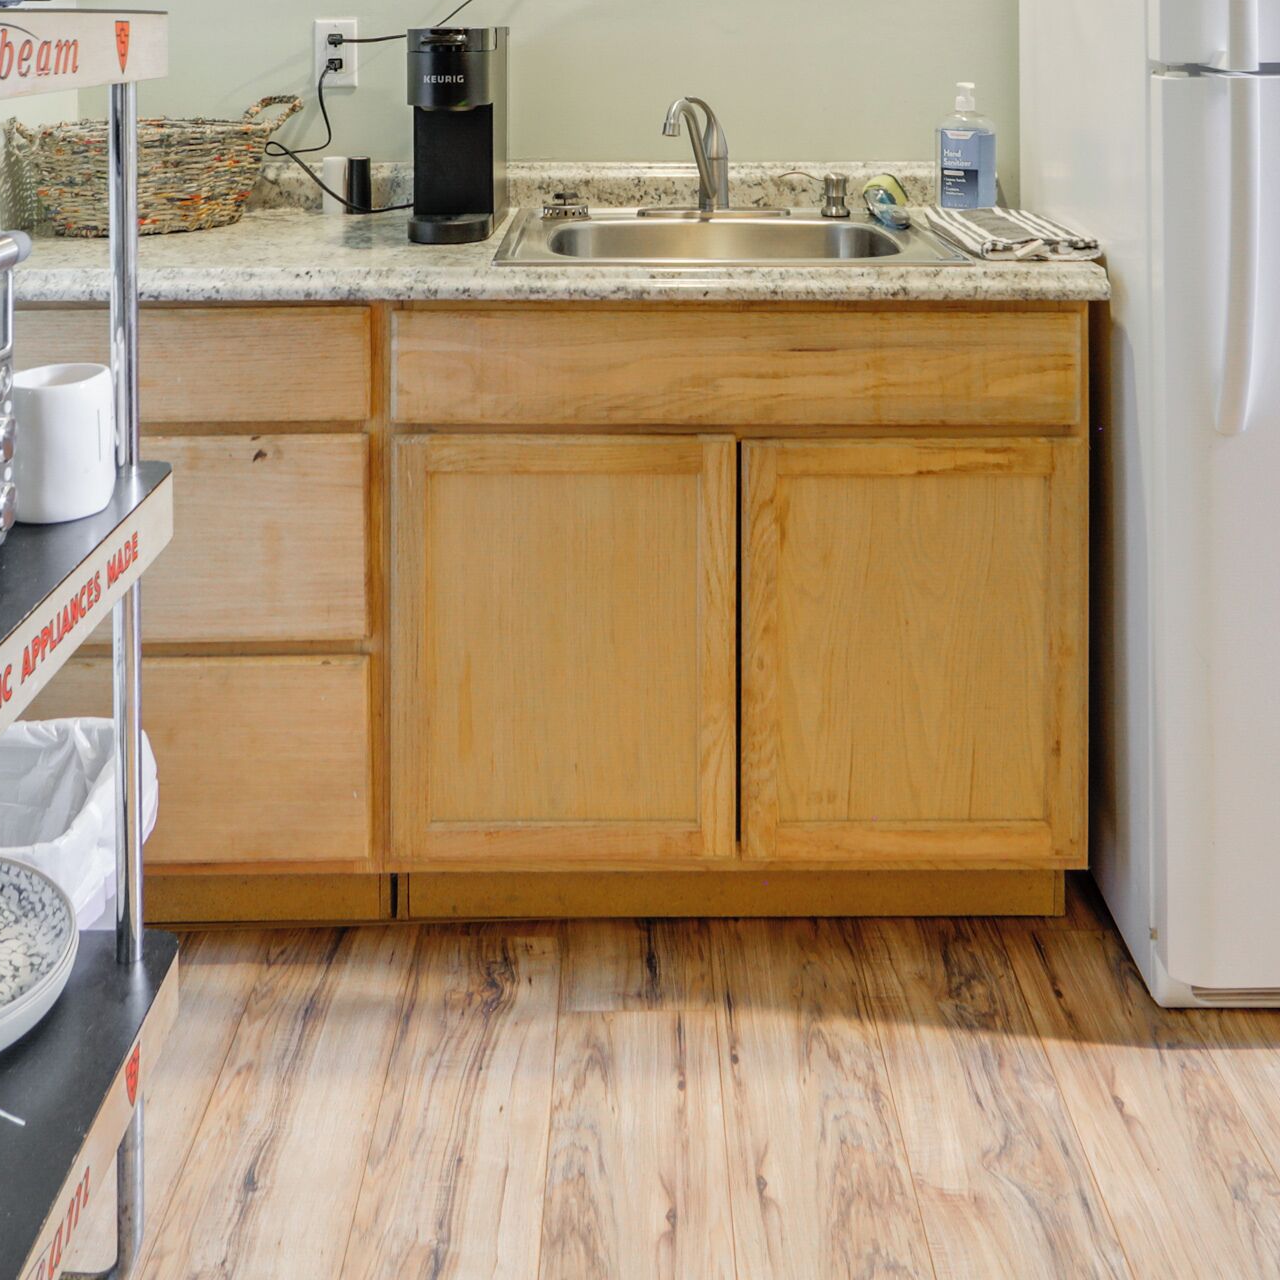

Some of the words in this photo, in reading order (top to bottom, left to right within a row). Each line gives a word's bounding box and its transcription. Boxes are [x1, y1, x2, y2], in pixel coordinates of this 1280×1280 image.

[423, 75, 465, 84] KEURIG
[943, 148, 961, 158] Hand
[943, 158, 972, 167] Sanitizer
[21, 570, 101, 685] APPLIANCES
[107, 532, 139, 589] MADE
